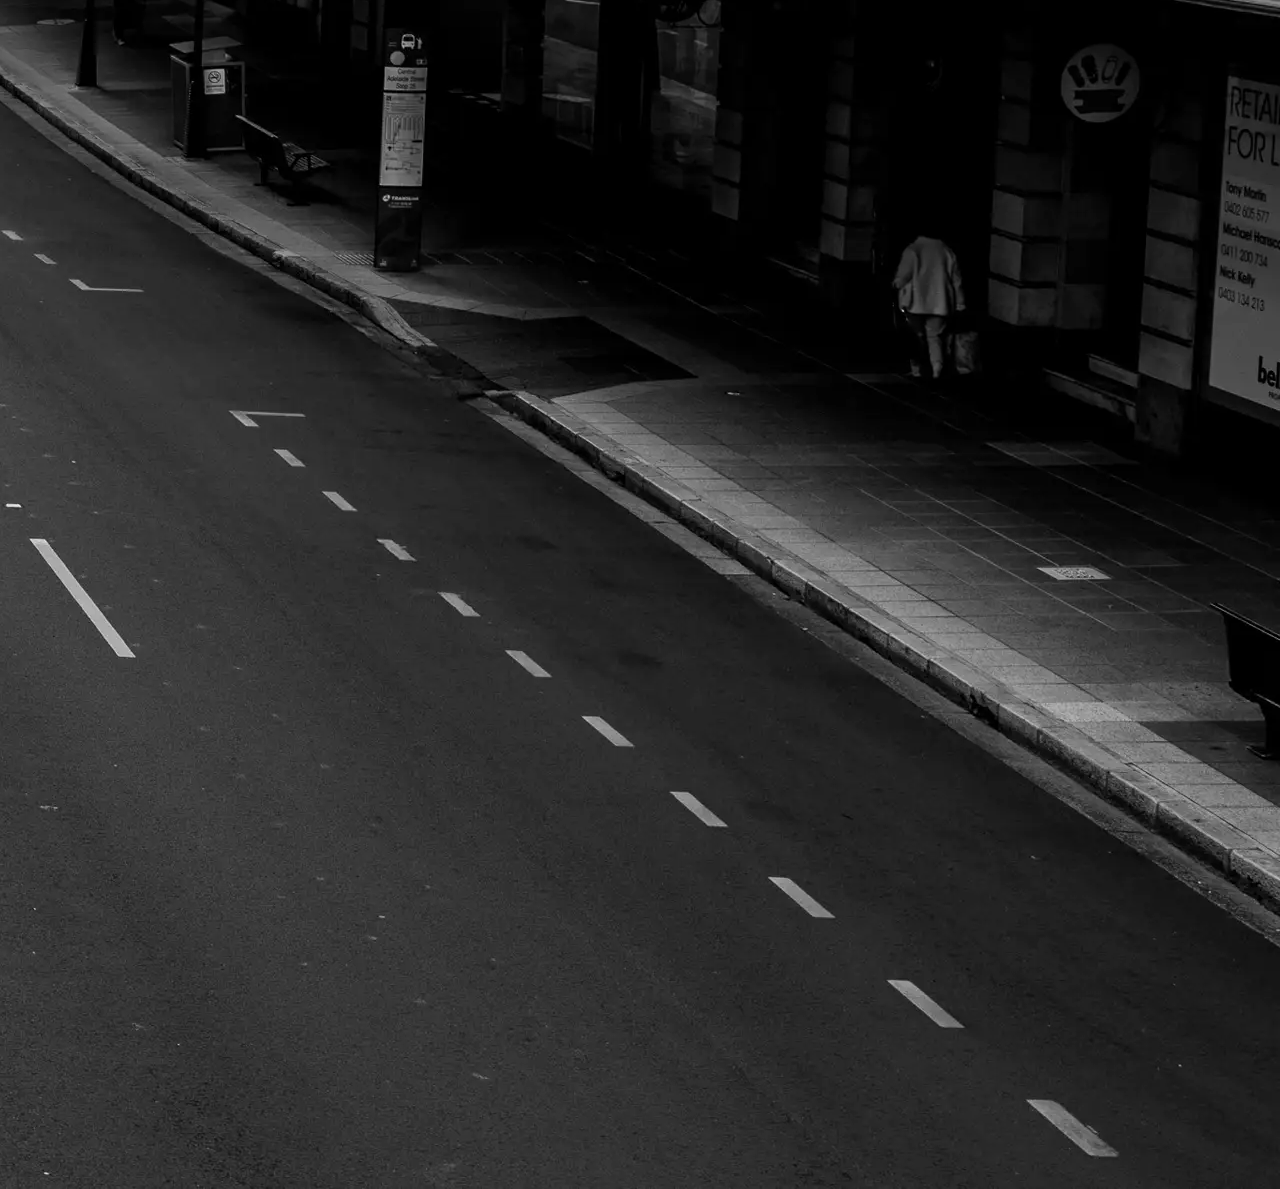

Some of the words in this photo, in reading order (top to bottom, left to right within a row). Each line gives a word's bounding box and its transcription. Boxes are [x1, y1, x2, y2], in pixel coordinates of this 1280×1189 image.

[1228, 126, 1264, 163] FOR
[1225, 181, 1242, 198] Tony
[1223, 221, 1253, 241] Michael
[1220, 264, 1237, 281] Nick
[1237, 270, 1256, 288] Kelly
